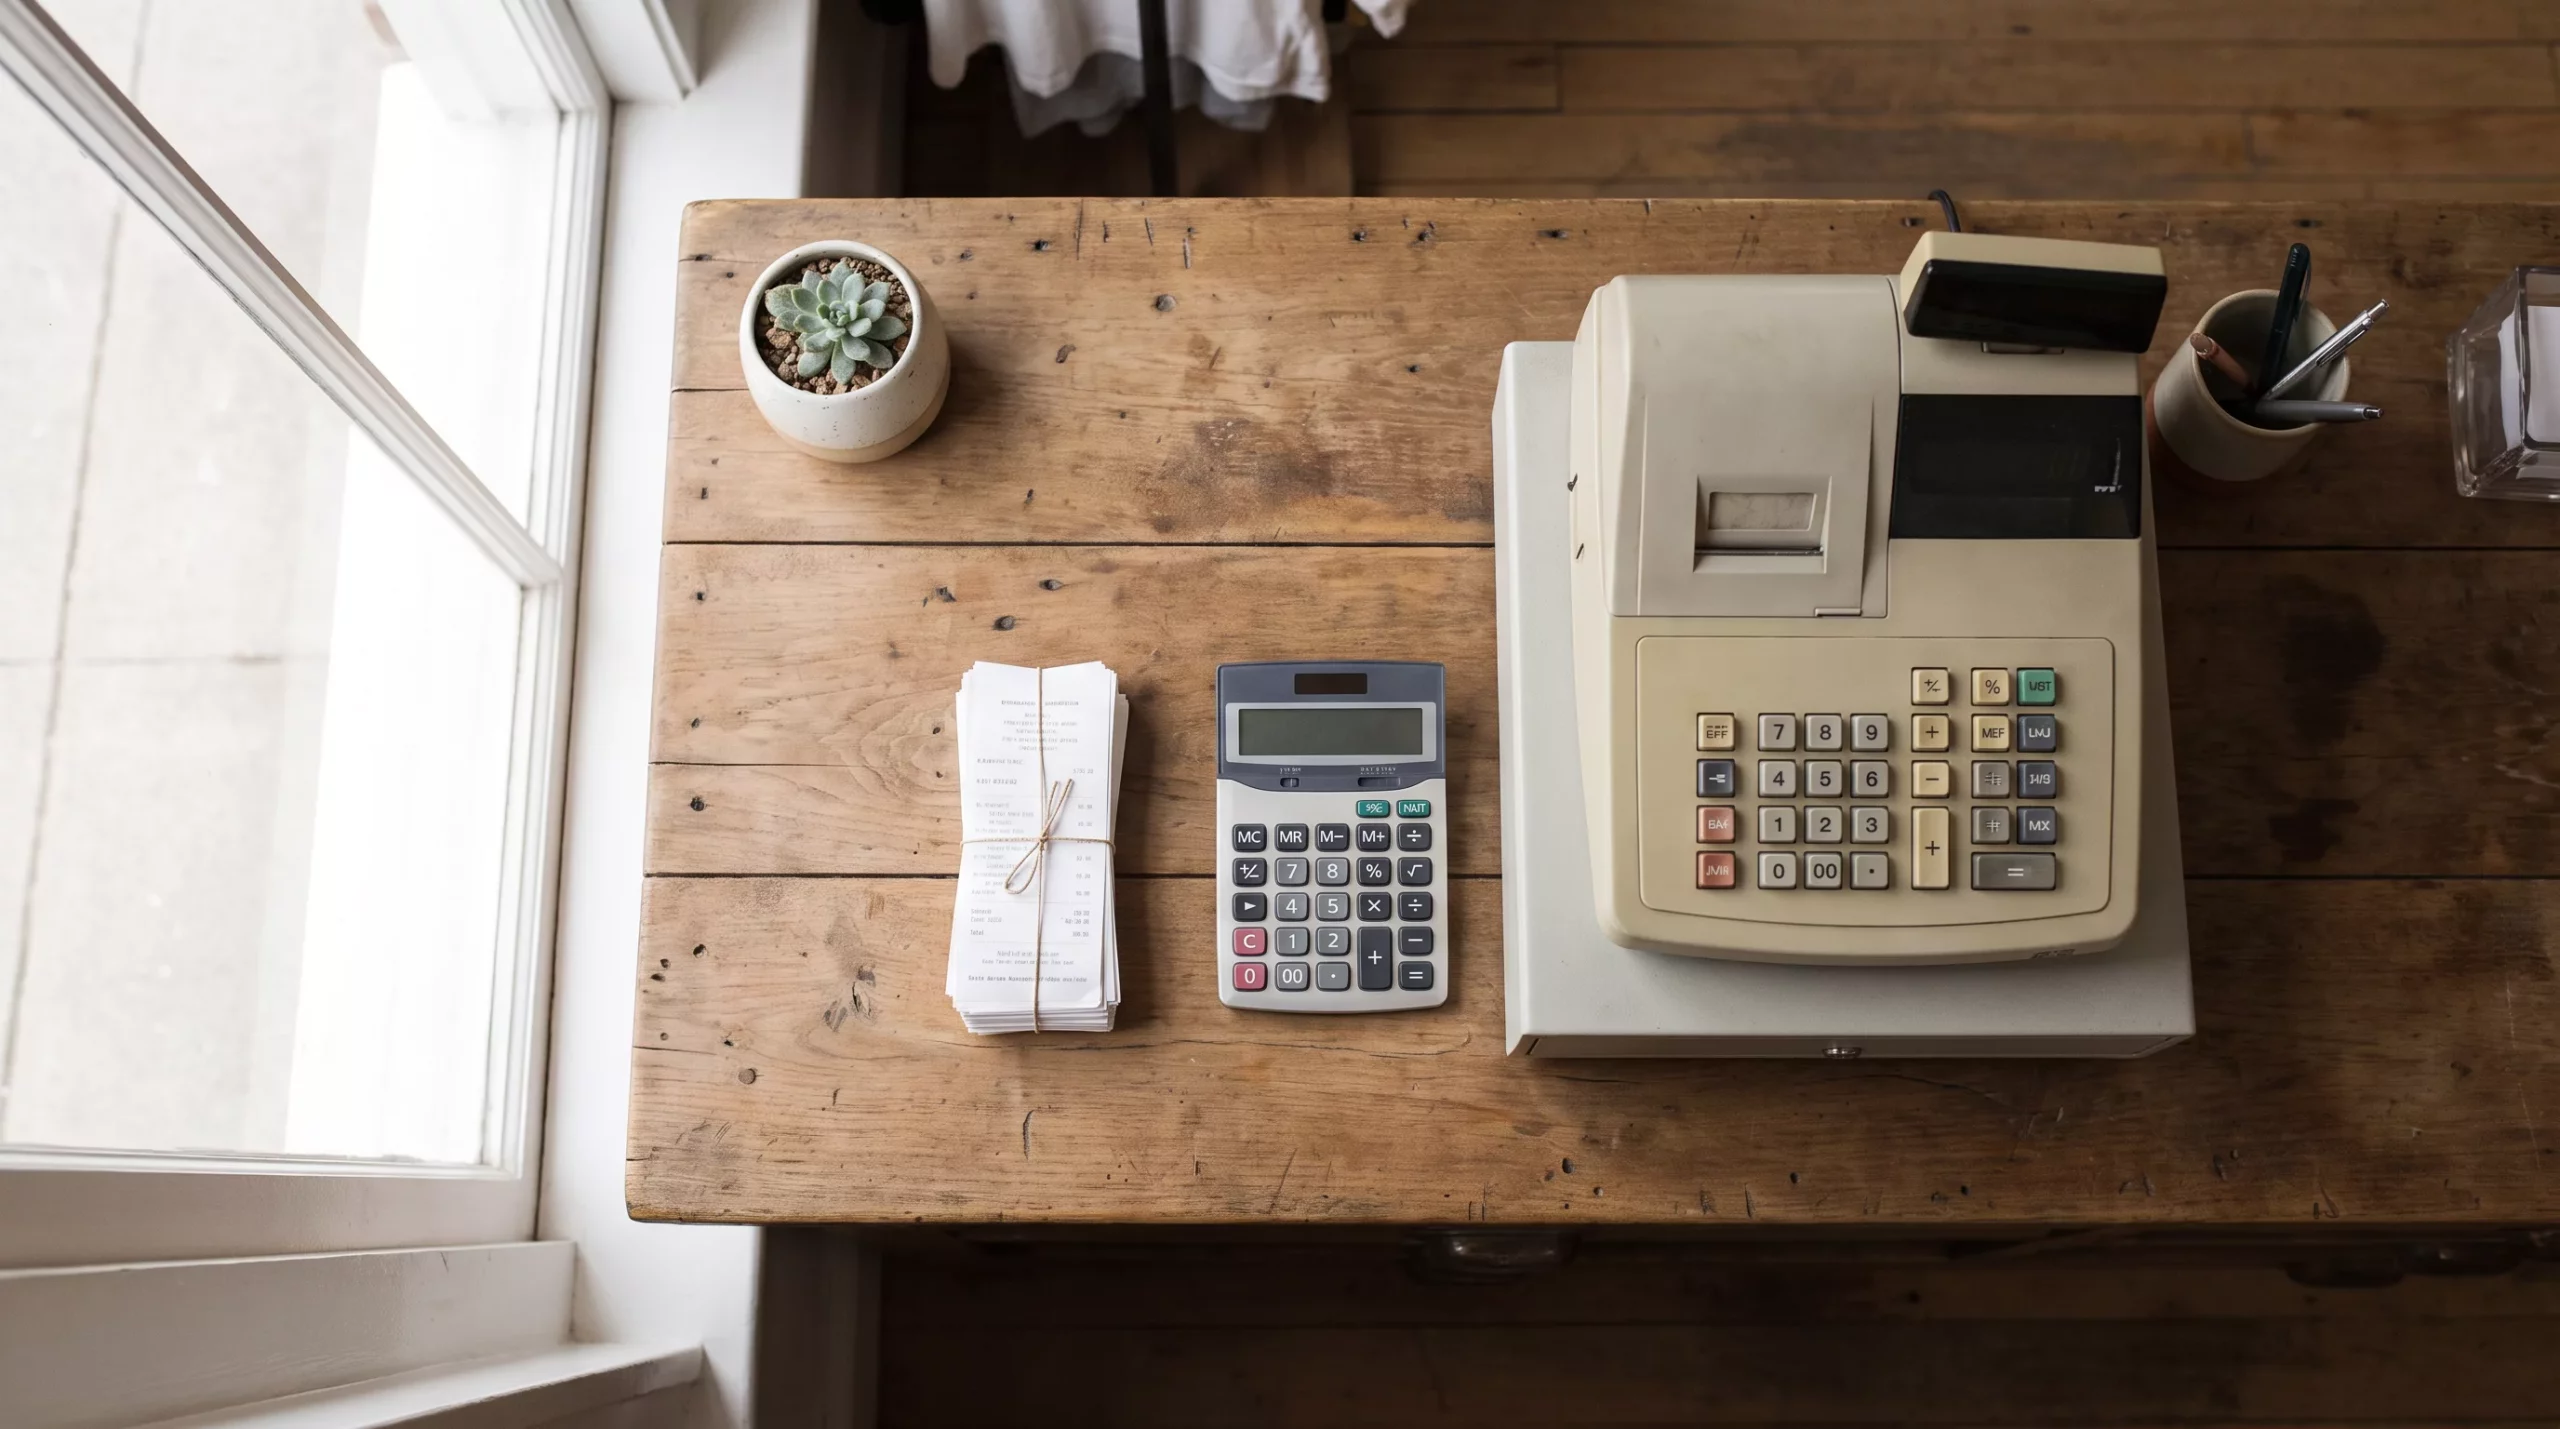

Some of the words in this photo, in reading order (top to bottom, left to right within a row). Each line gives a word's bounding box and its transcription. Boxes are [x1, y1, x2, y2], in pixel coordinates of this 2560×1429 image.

[1773, 724, 1784, 740] 7
[1819, 725, 1832, 740] 8
[1866, 725, 1878, 740] 9
[1982, 728, 2005, 738] MEF
[1773, 771, 1784, 786] 4
[1819, 771, 1831, 786] 5
[1866, 771, 1878, 786] 6
[1775, 817, 1782, 832] 1
[1819, 817, 1832, 832] 2
[1866, 817, 1877, 833] 3
[2029, 820, 2050, 831] MX
[1238, 831, 1261, 843] MC
[1280, 831, 1302, 843] MR
[1362, 830, 1385, 843] M+
[1287, 864, 1298, 879] 7
[1327, 864, 1338, 879] 8
[1366, 864, 1382, 878] %
[1773, 863, 1785, 879] 0
[1813, 863, 1837, 879] 00
[1285, 899, 1297, 914] 4
[1327, 899, 1339, 914] 5
[1243, 934, 1256, 948] C
[1289, 934, 1296, 948] 1
[1328, 933, 1339, 948] 2
[1245, 969, 1255, 984] 0
[1282, 969, 1302, 984] 00
